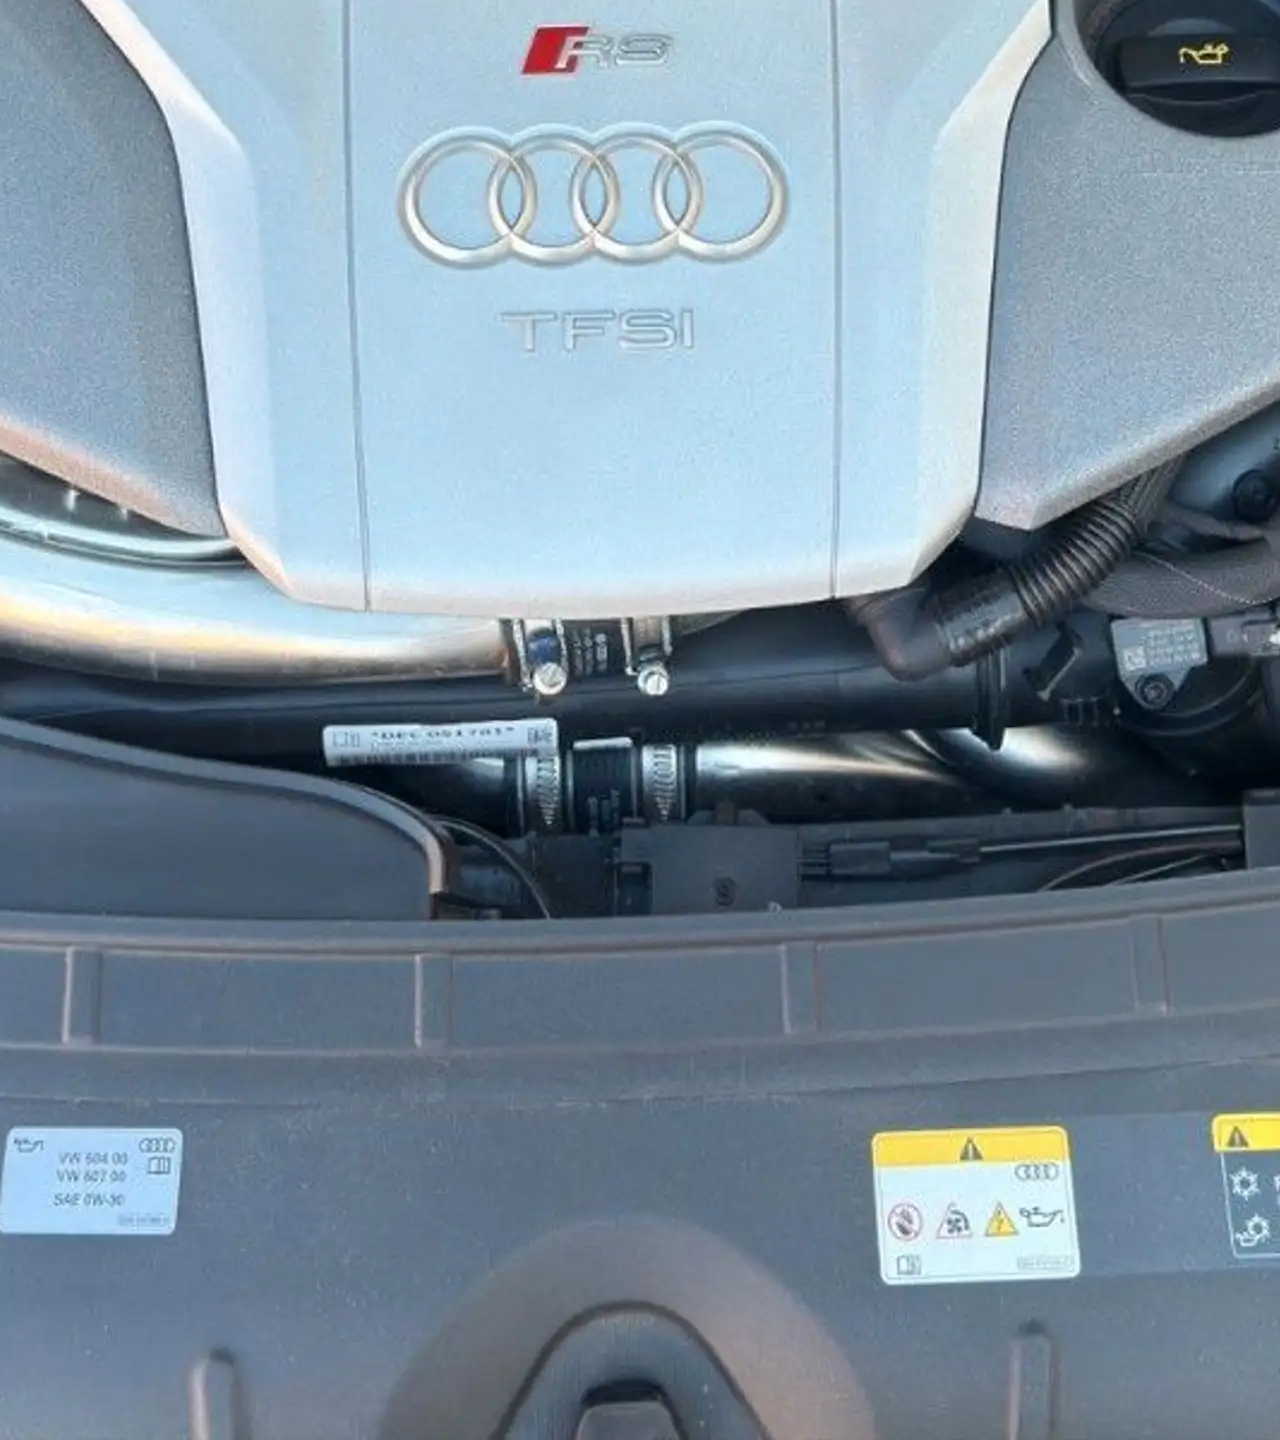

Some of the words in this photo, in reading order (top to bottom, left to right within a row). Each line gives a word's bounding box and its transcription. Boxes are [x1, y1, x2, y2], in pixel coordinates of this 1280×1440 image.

[548, 31, 674, 71] RS
[497, 306, 697, 354] TFSI
[59, 1152, 81, 1165] VW
[56, 1167, 79, 1182] VW
[54, 1191, 81, 1206] SAE
